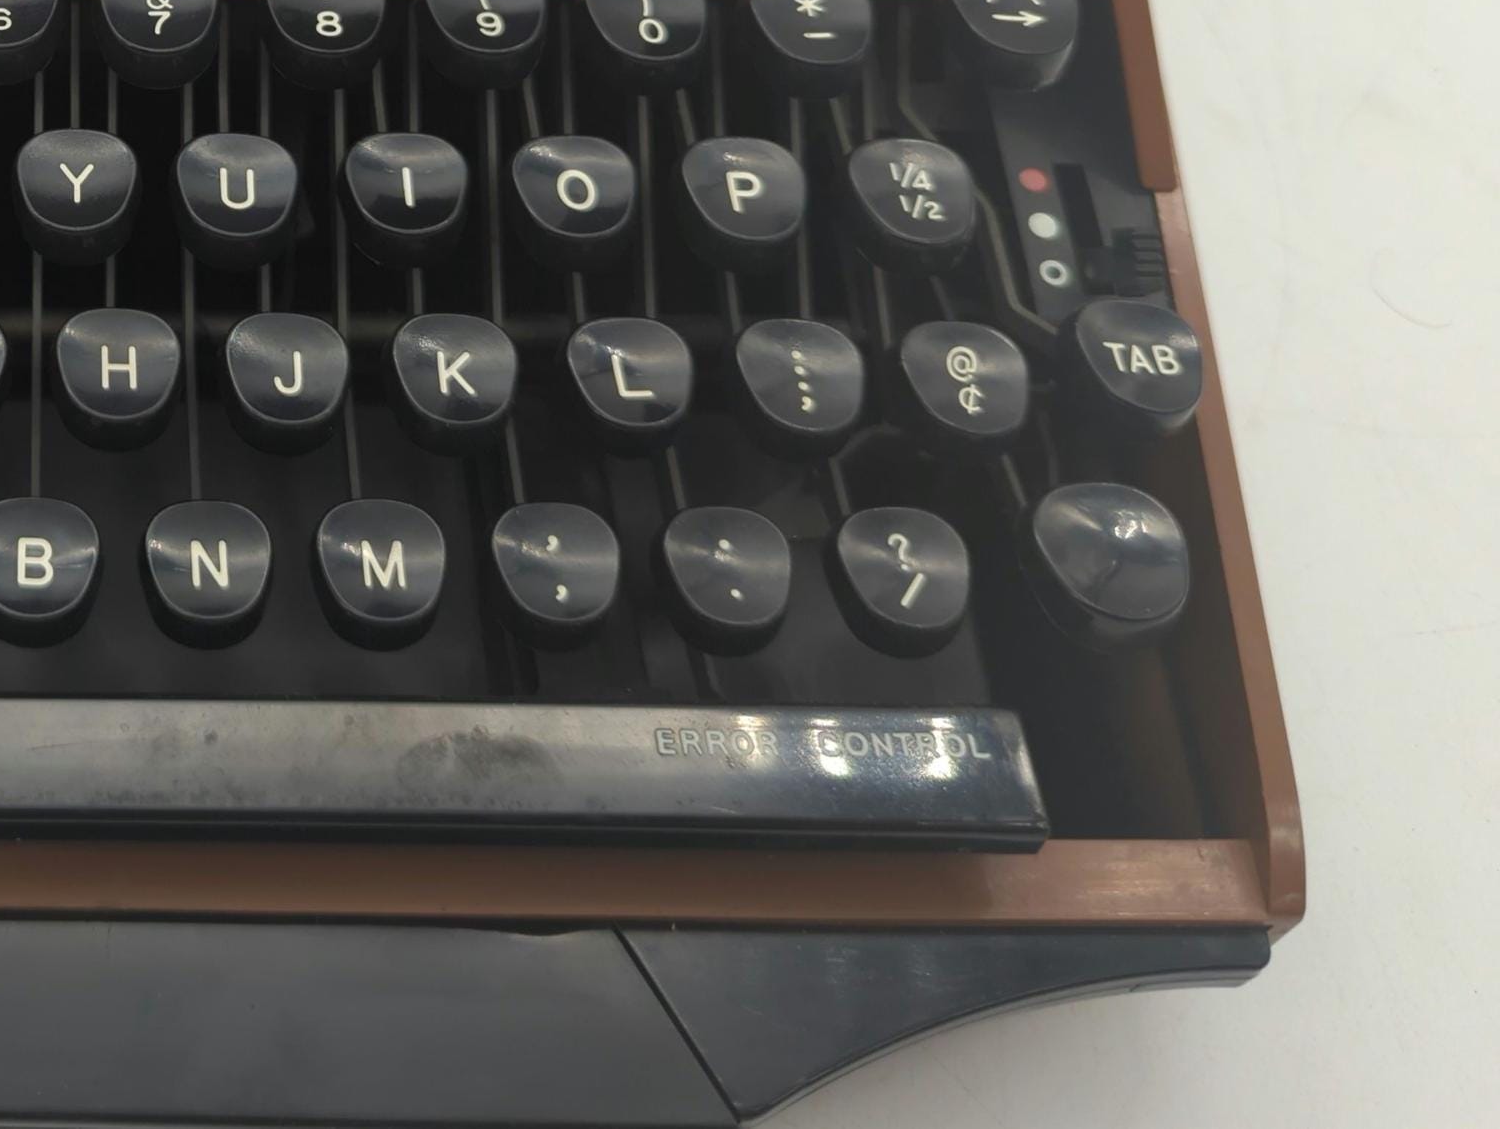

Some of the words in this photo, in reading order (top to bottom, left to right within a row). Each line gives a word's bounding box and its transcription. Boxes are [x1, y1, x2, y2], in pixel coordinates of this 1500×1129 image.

[147, 10, 171, 35] 7
[315, 10, 343, 37] 8
[476, 11, 503, 37] 9
[638, 18, 665, 44] 0
[59, 163, 95, 203] Y
[219, 167, 255, 210] U
[401, 166, 414, 207] I
[556, 169, 597, 211] O
[726, 170, 763, 212] P
[101, 345, 138, 390] H
[273, 350, 303, 395] J
[436, 350, 476, 395] K
[611, 354, 654, 398] L
[1103, 342, 1180, 375] TAB
[17, 537, 54, 587] B
[190, 540, 229, 588] N
[360, 540, 406, 588] M
[654, 727, 779, 757] ERROR
[816, 730, 992, 760] CONTROL
